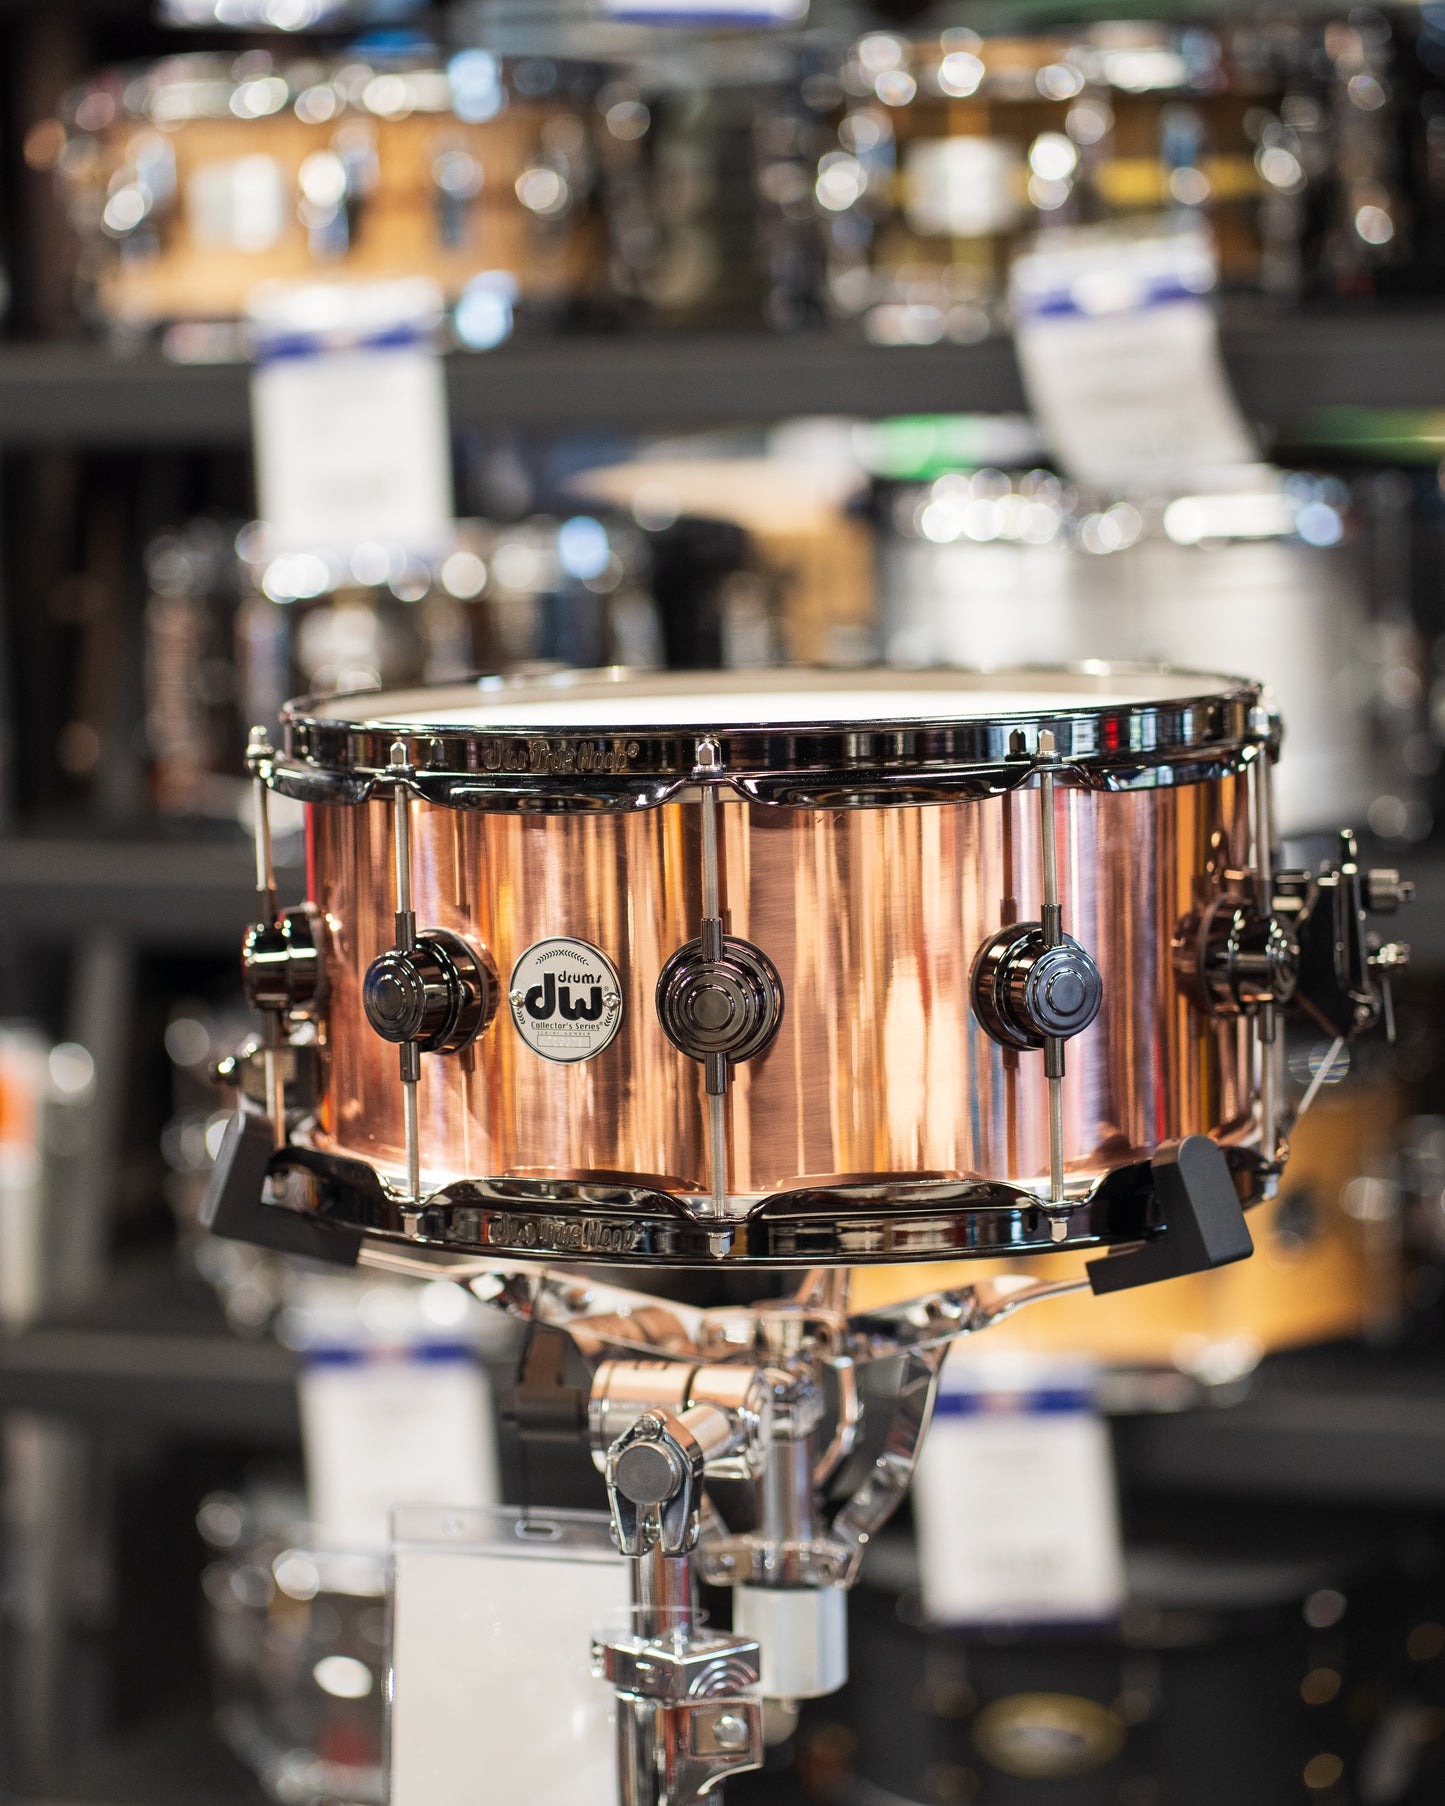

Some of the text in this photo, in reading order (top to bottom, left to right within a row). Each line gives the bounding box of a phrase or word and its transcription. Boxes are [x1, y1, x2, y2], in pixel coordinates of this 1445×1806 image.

[558, 970, 602, 984] drums
[524, 973, 602, 1021] dw
[531, 1021, 573, 1030] Collector's
